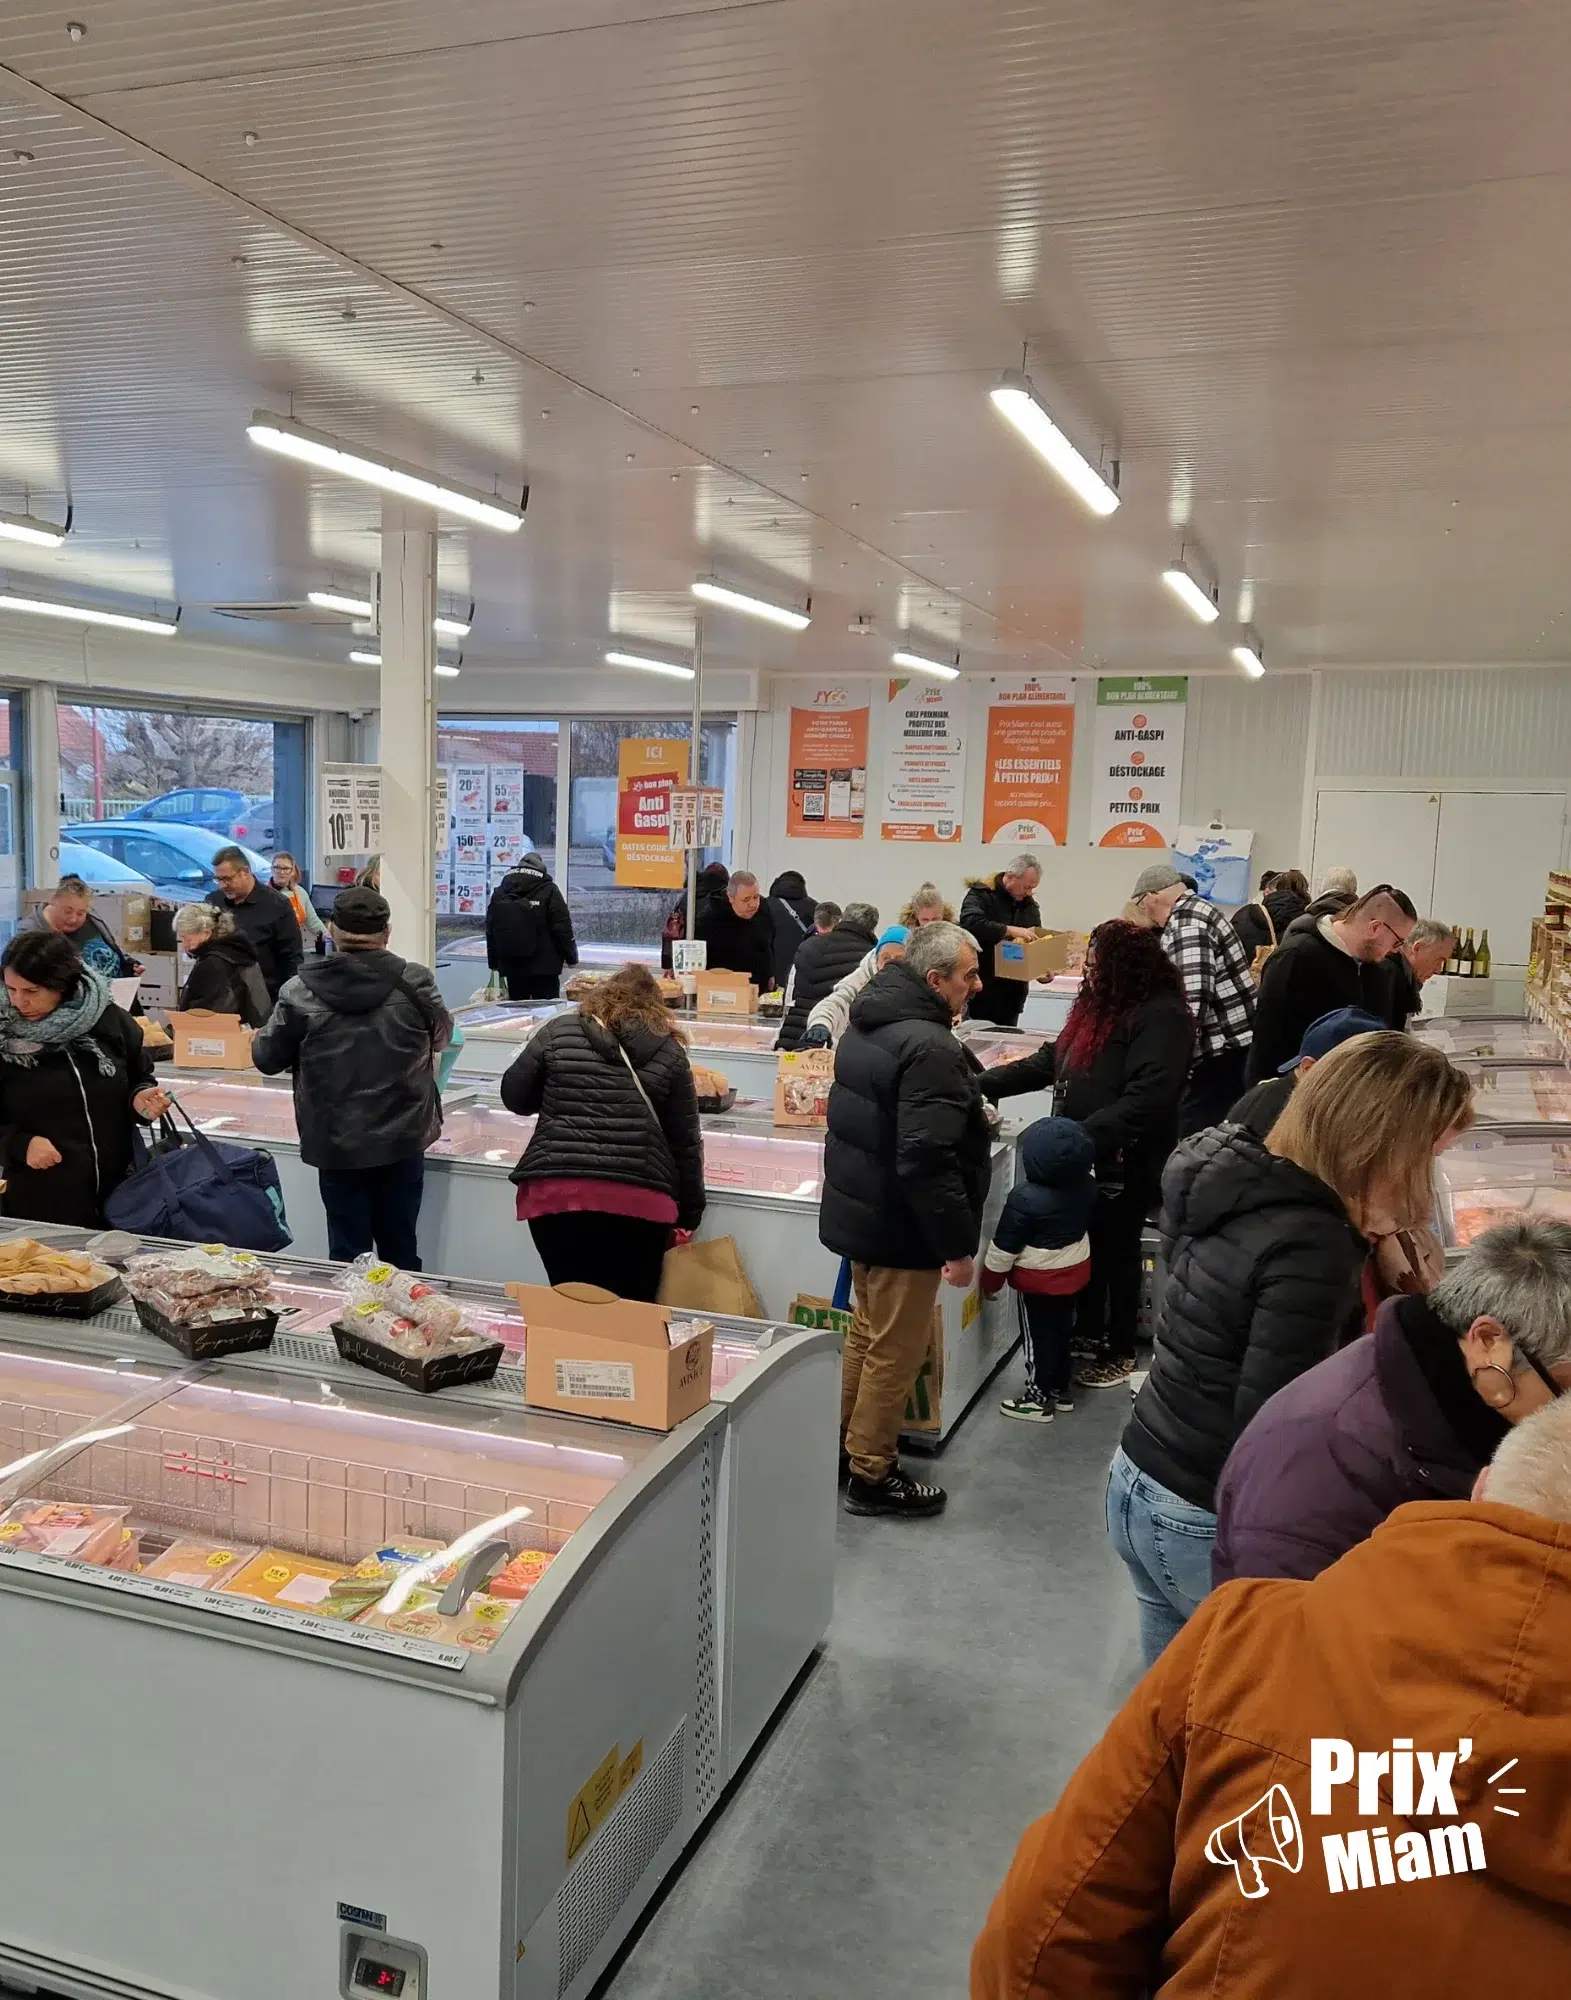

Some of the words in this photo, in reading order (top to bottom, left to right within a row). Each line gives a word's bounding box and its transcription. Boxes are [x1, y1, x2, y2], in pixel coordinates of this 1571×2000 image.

[905, 710, 919, 718] CHEZ
[908, 720, 934, 728] PROFITEZ
[934, 720, 945, 728] DES
[1114, 730, 1164, 740] ANTI-GASPI
[646, 747, 662, 758] ICI
[1014, 759, 1061, 770] ESSENTIELS
[994, 769, 1000, 783] À
[1001, 772, 1029, 783] PETITS
[1109, 764, 1166, 777] DÉSTOCKAGE
[644, 780, 657, 788] bon
[638, 795, 664, 811] Anti
[1109, 803, 1139, 814] PETITS
[1140, 803, 1160, 814] PRIX
[329, 812, 346, 850] 10
[361, 814, 369, 848] 7
[686, 820, 691, 845] 8
[626, 852, 676, 863] DÉSTOCKAGE
[520, 868, 544, 878] SYSTEM
[484, 1606, 500, 1616] 8€
